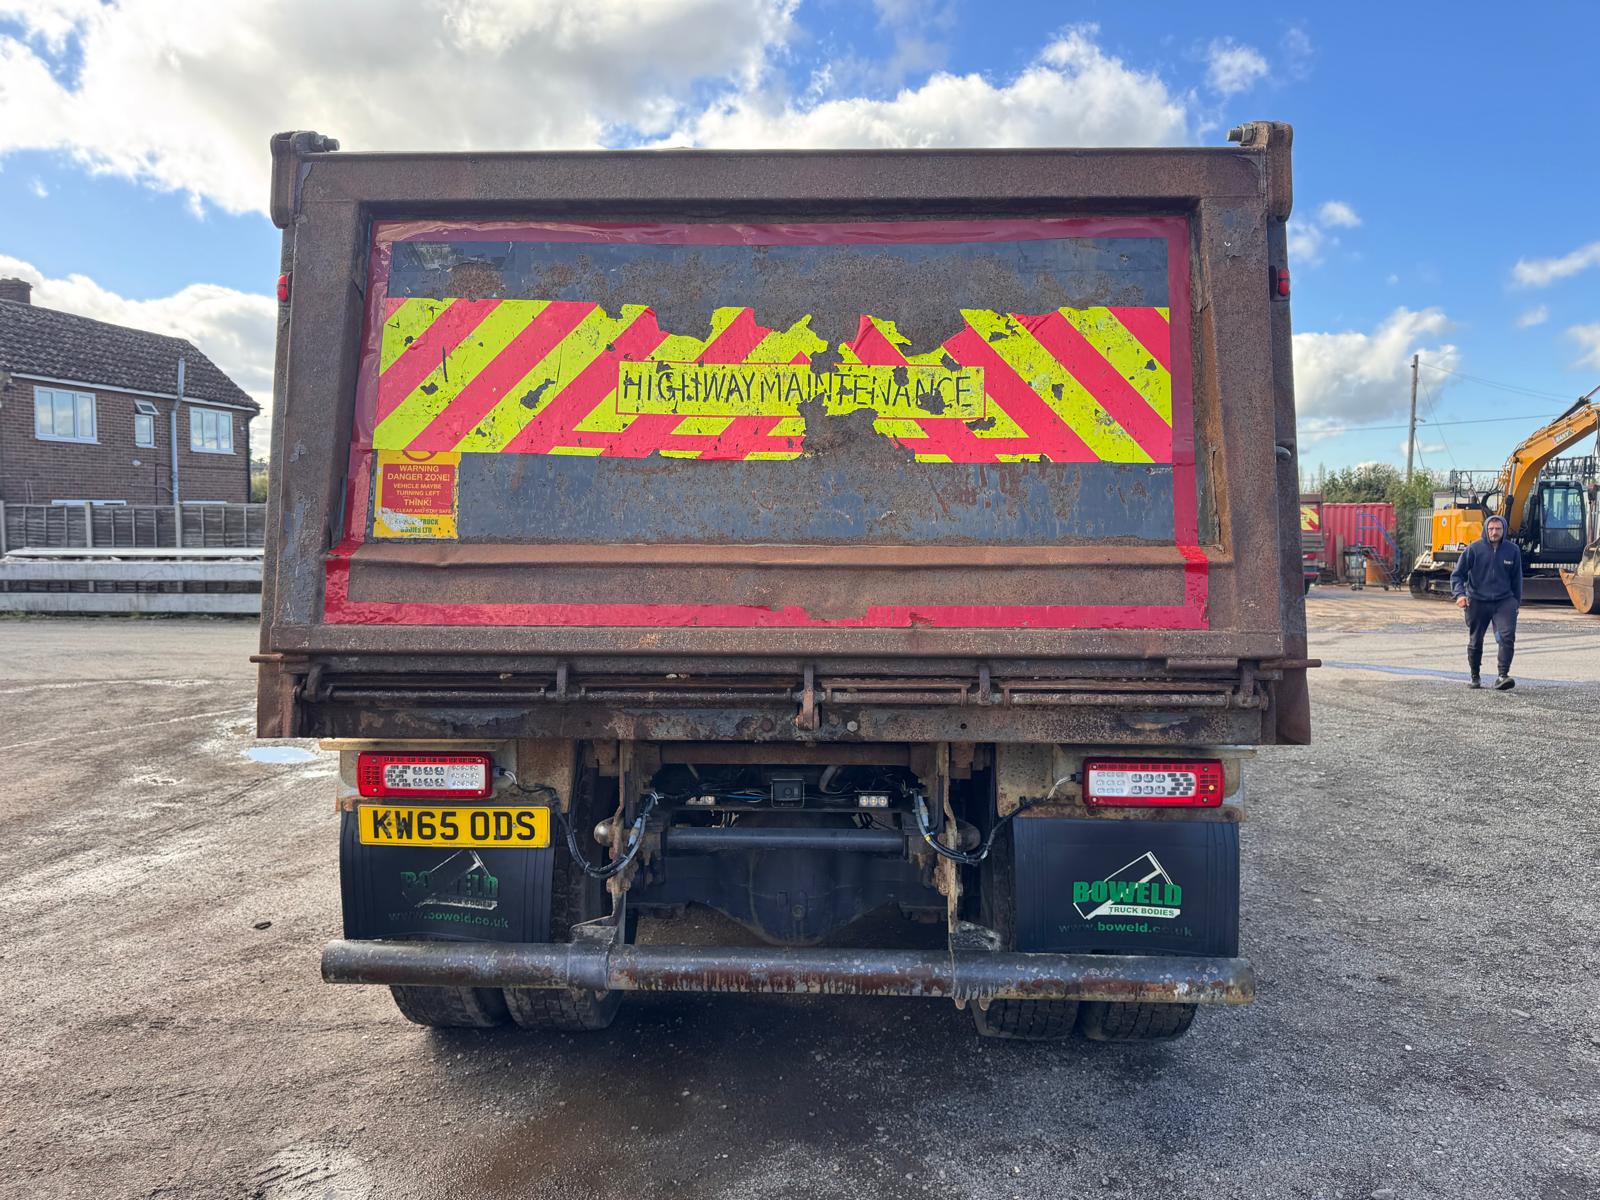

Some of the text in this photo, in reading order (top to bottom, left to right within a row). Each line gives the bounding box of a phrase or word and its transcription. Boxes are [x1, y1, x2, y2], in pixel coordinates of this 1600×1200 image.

[399, 465, 439, 473] WARNING
[372, 810, 536, 841] KW65 ODS
[1073, 880, 1182, 906] BOWELD
[1108, 906, 1175, 916] TRUCK BODIES
